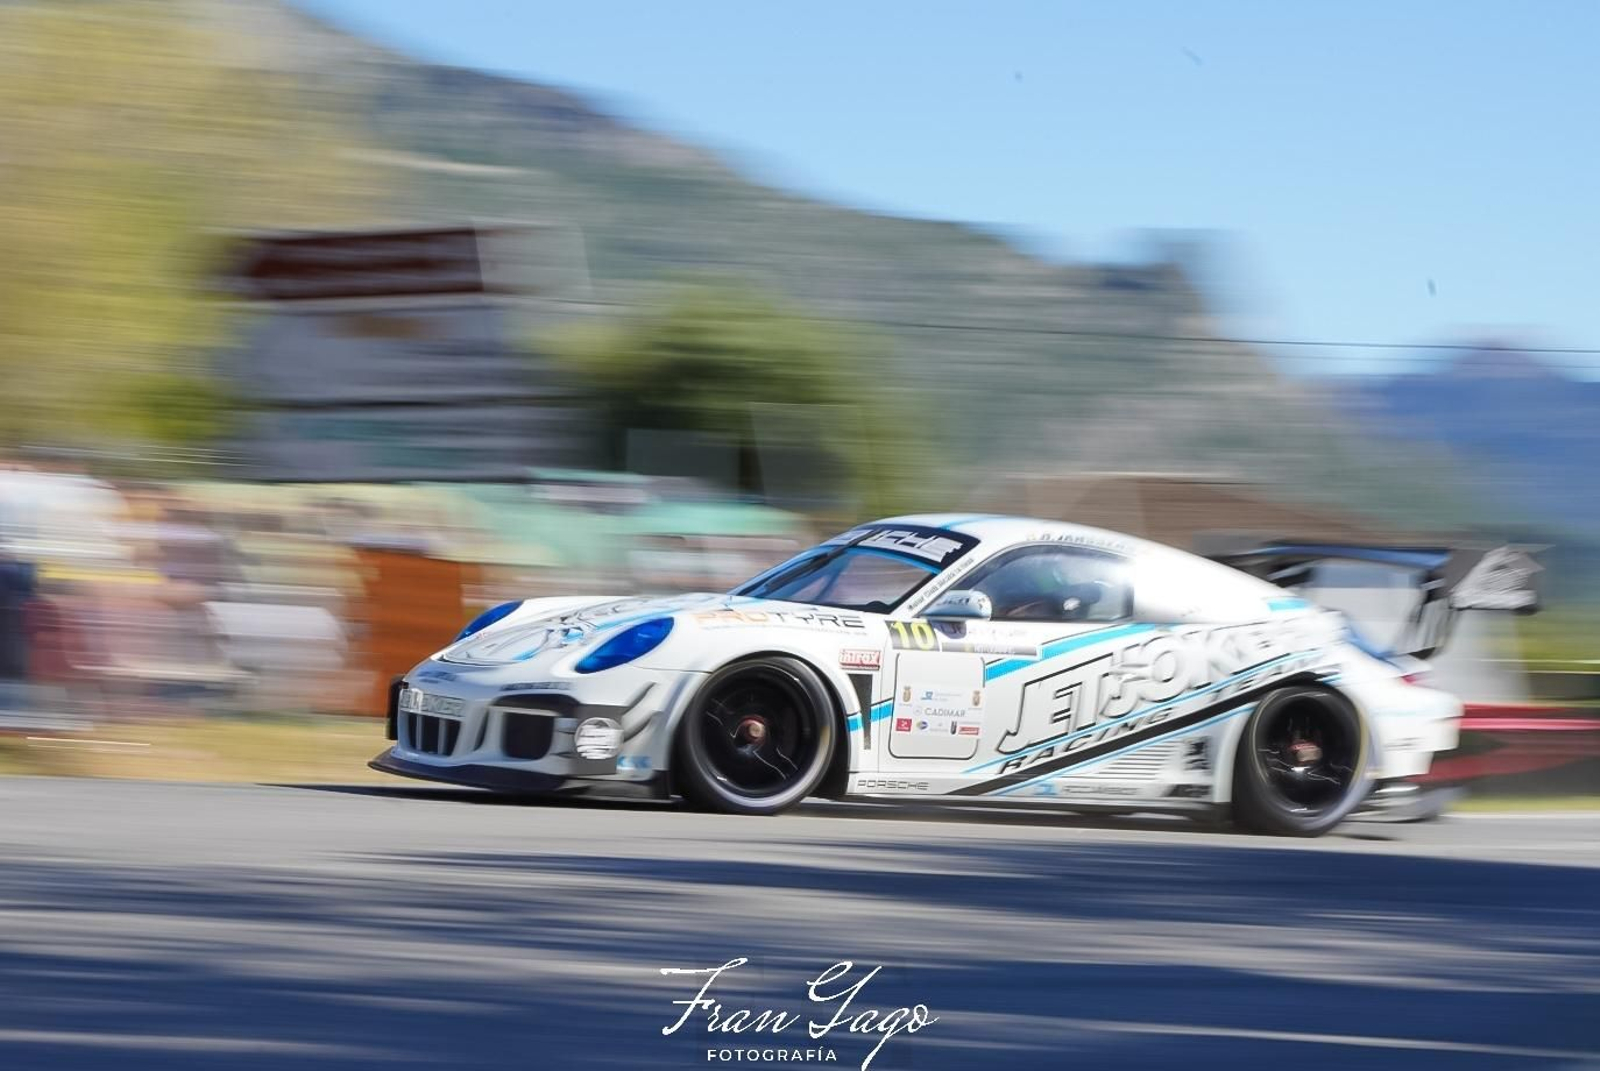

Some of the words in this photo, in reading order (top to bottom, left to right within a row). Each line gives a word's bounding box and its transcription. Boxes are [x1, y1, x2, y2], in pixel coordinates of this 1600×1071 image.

[691, 610, 866, 629] PROTYRE
[891, 621, 936, 650] 10
[924, 707, 967, 718] CADIMAR
[999, 706, 1176, 776] RACING
[857, 779, 930, 791] PORSCHE
